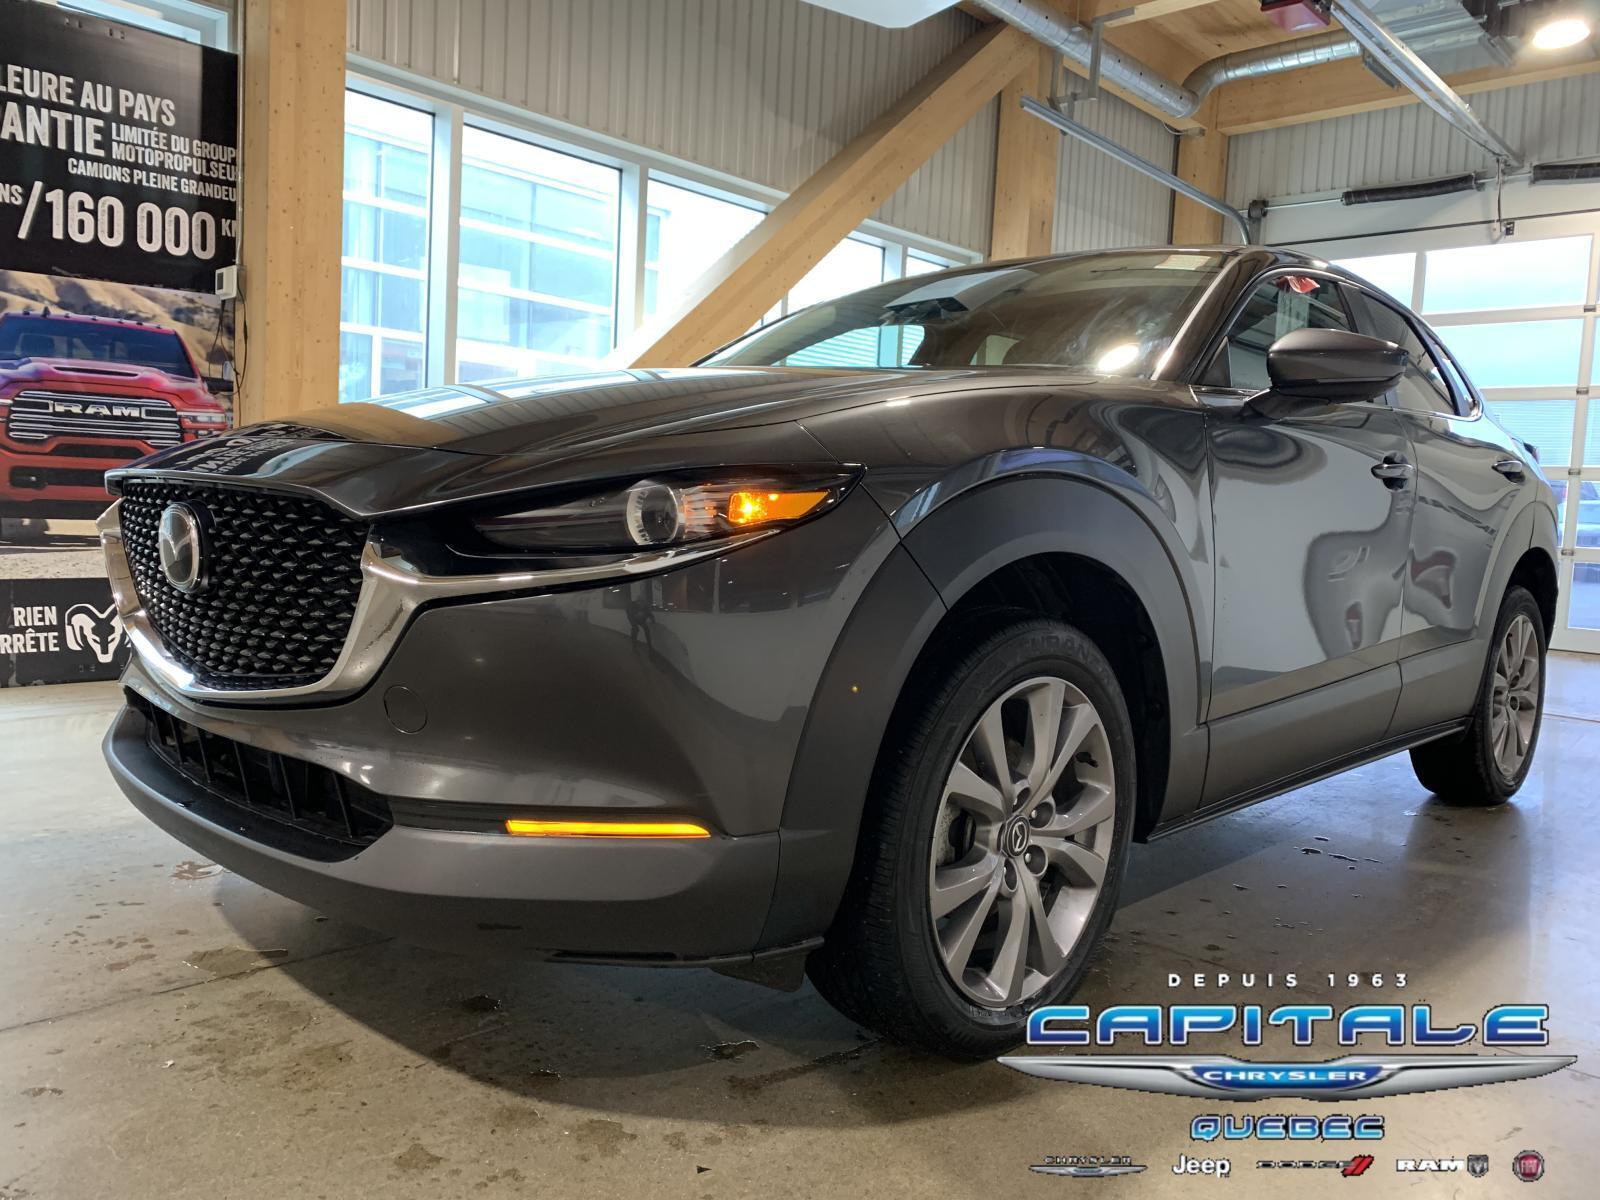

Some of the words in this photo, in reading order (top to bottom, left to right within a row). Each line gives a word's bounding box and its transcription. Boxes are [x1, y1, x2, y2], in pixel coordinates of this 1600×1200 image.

[80, 81, 112, 113] AU
[119, 89, 176, 126] PAYS
[1, 101, 105, 157] ANTIE
[111, 122, 168, 150] LIMITÉE
[170, 136, 190, 155] DU
[68, 157, 130, 183] CAMIONS
[133, 169, 178, 192] PLEINE
[137, 201, 216, 260] 000
[54, 402, 141, 418] RAM
[13, 606, 57, 627] RIEN
[0, 628, 60, 654] RRÊTE
